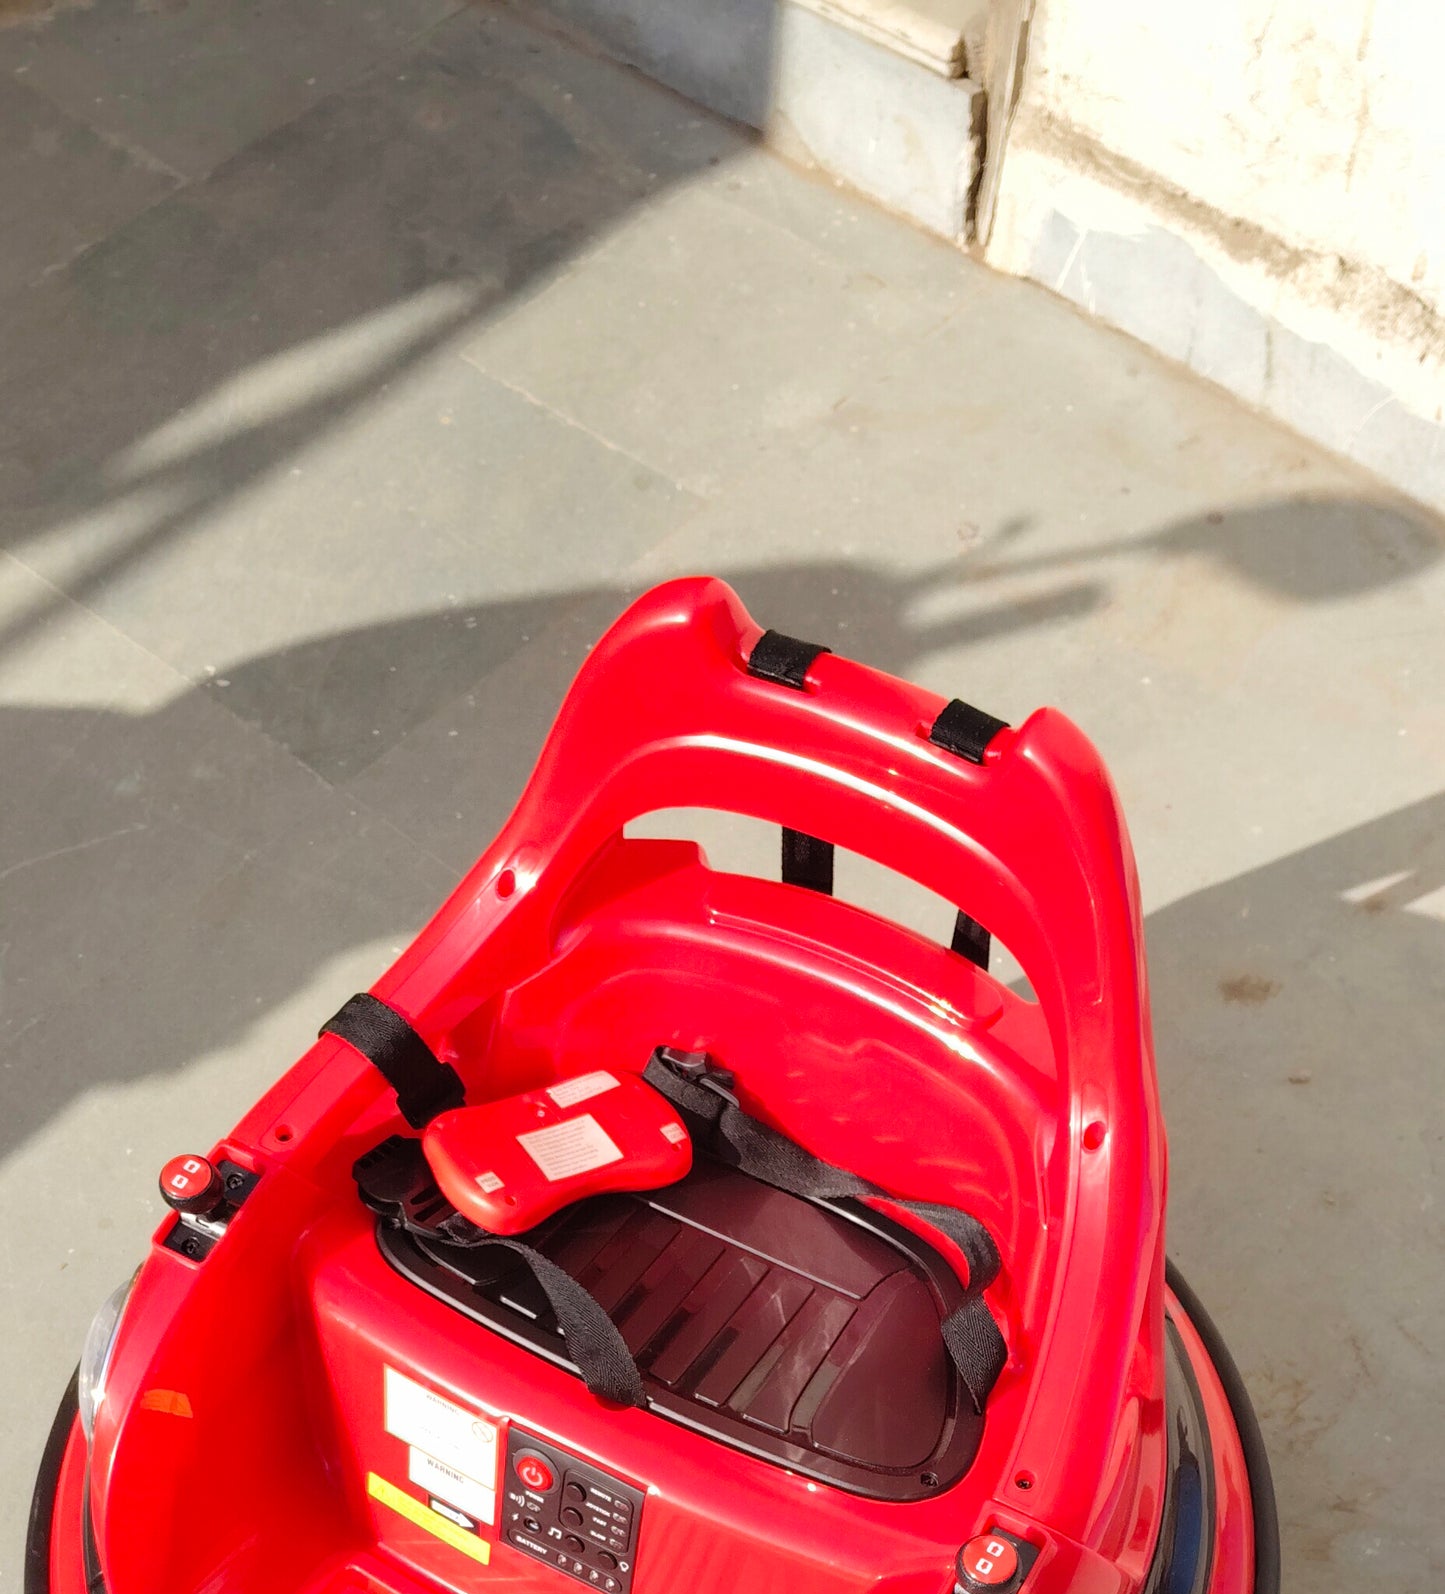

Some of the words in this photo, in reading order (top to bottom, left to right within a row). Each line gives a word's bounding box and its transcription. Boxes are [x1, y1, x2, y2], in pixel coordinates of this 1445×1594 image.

[427, 1458, 464, 1484] WARNING
[592, 1516, 607, 1527] FAST
[515, 1535, 548, 1555] BATTERY
